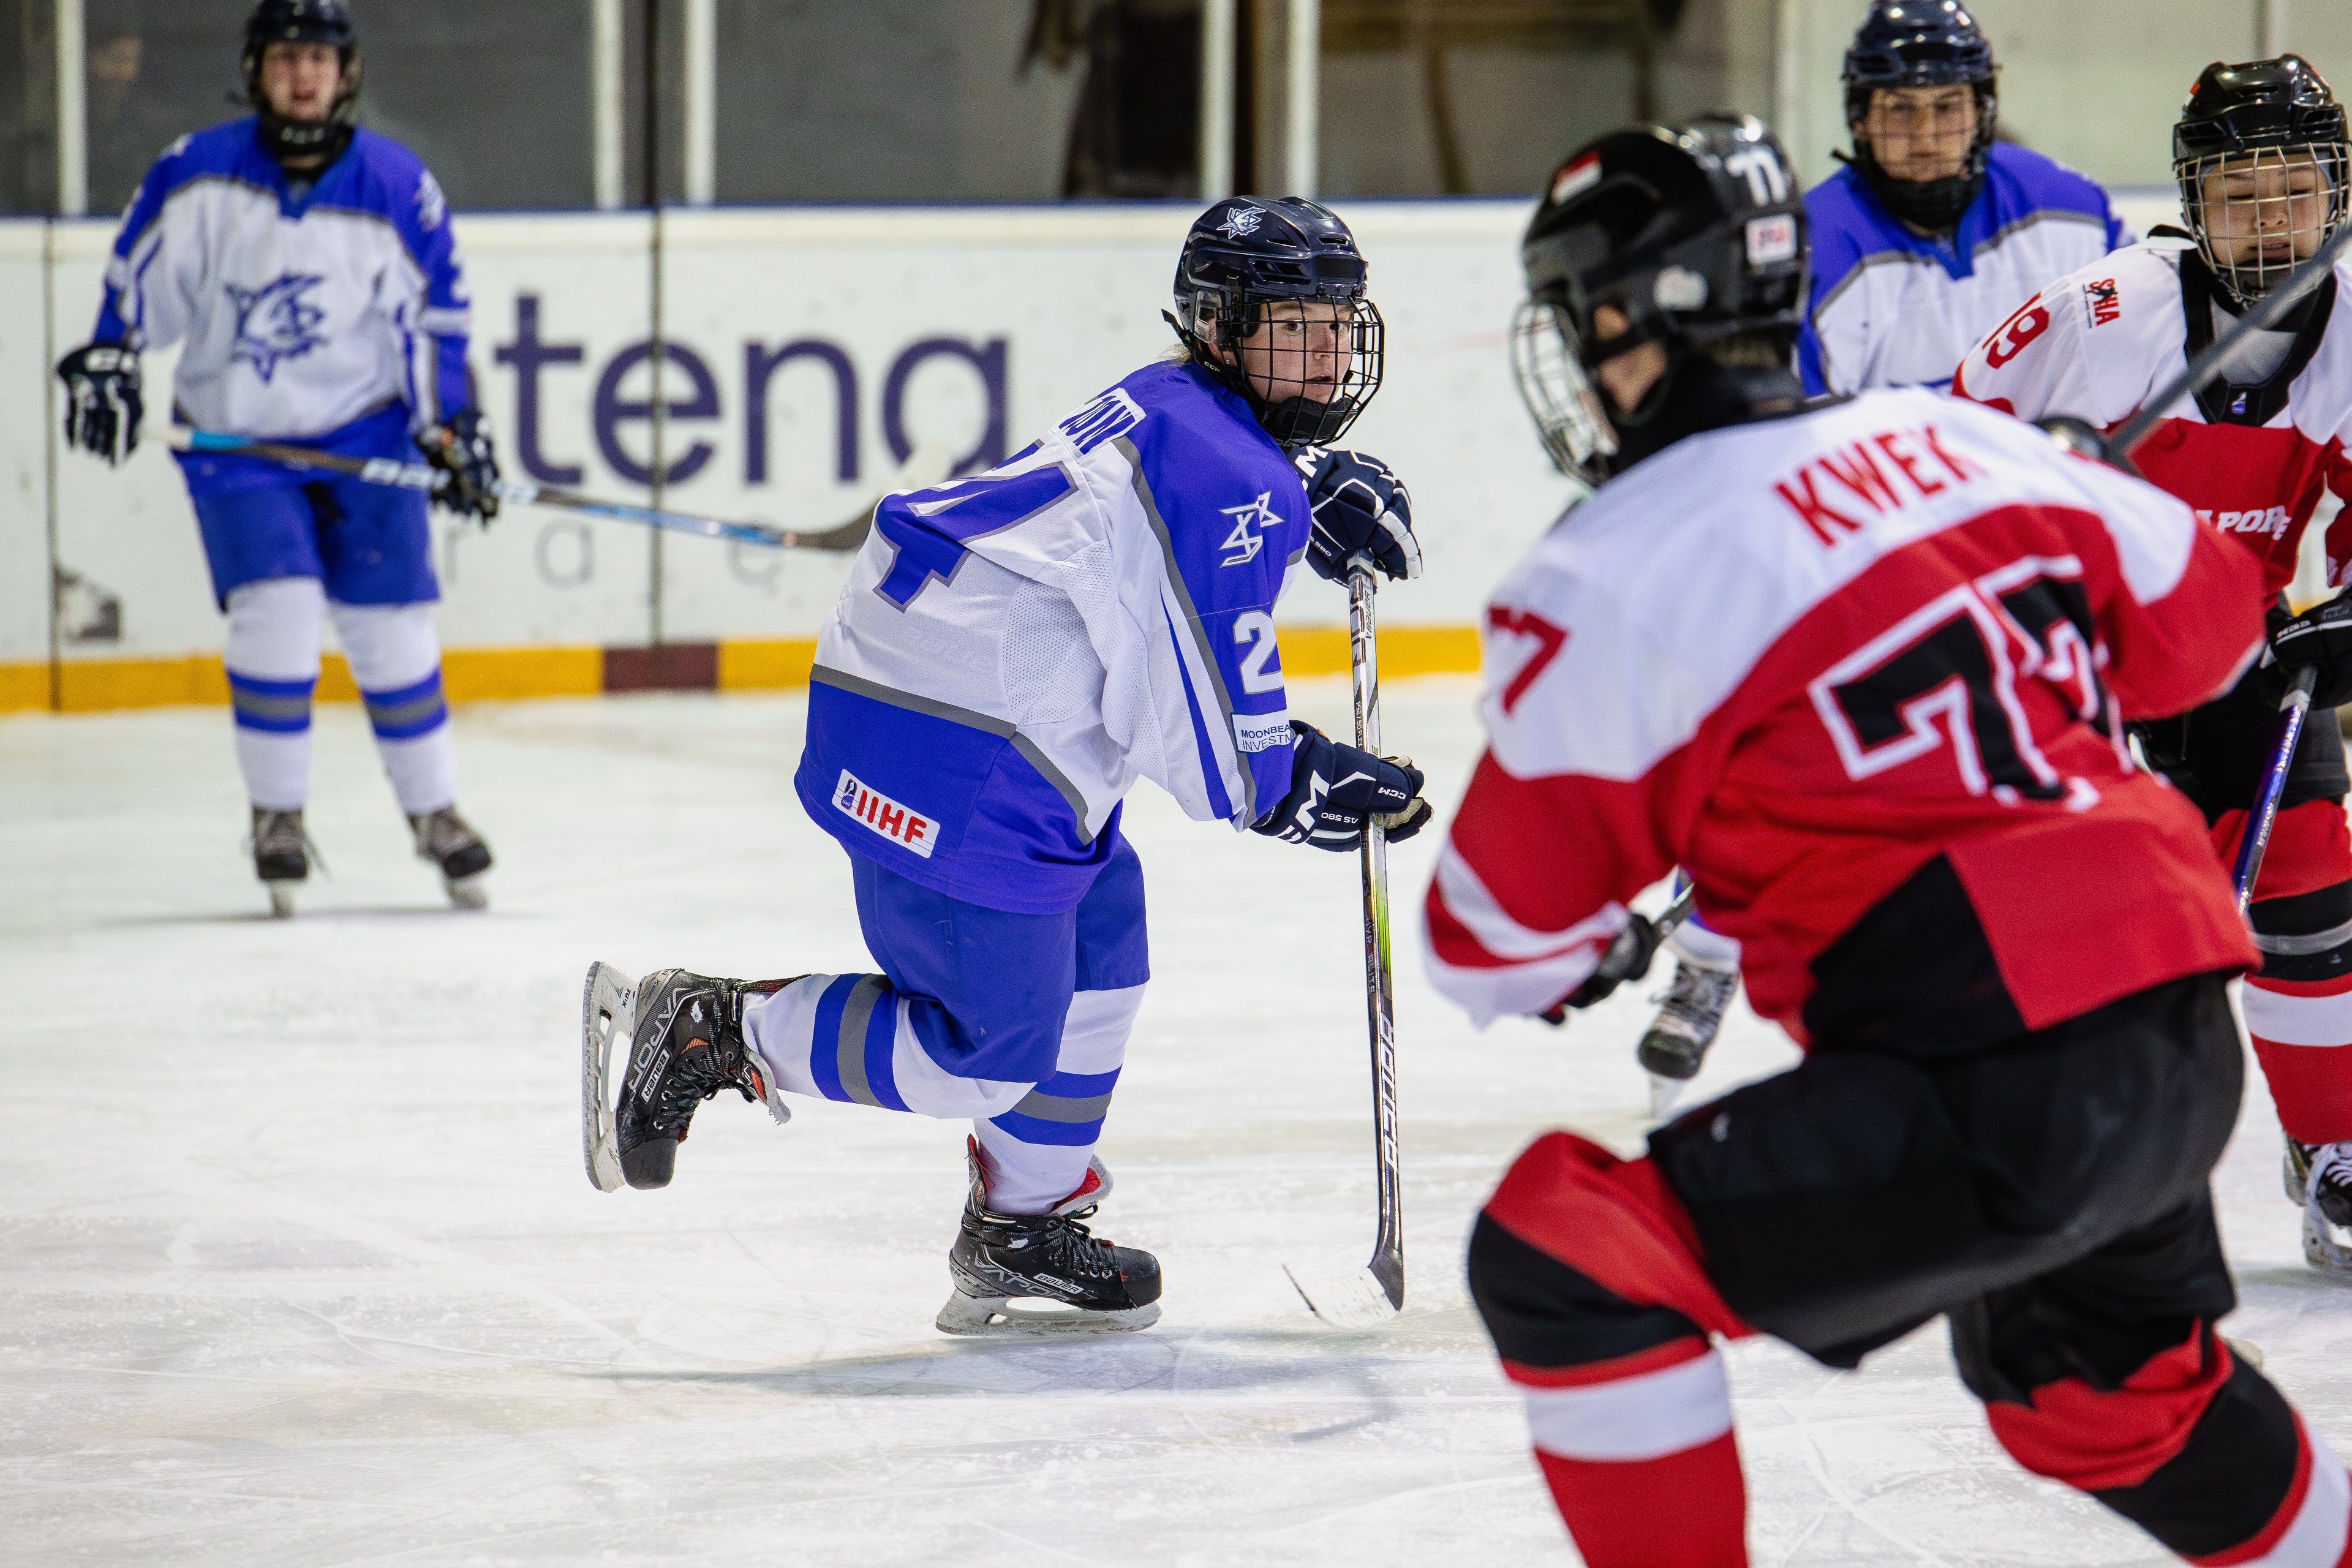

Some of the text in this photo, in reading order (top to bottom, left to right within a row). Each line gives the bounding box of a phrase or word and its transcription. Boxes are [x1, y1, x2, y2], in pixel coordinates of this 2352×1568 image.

[1774, 424, 1988, 548] KWEK
[1234, 609, 1284, 694] 2
[1806, 554, 2136, 812] 77
[857, 790, 927, 843] IIHF
[1321, 812, 1343, 821] 580
[1378, 786, 1406, 801] CCM
[628, 988, 692, 1098] VAPOR
[644, 1053, 667, 1098] BAUER
[1038, 1275, 1080, 1293] BAUER
